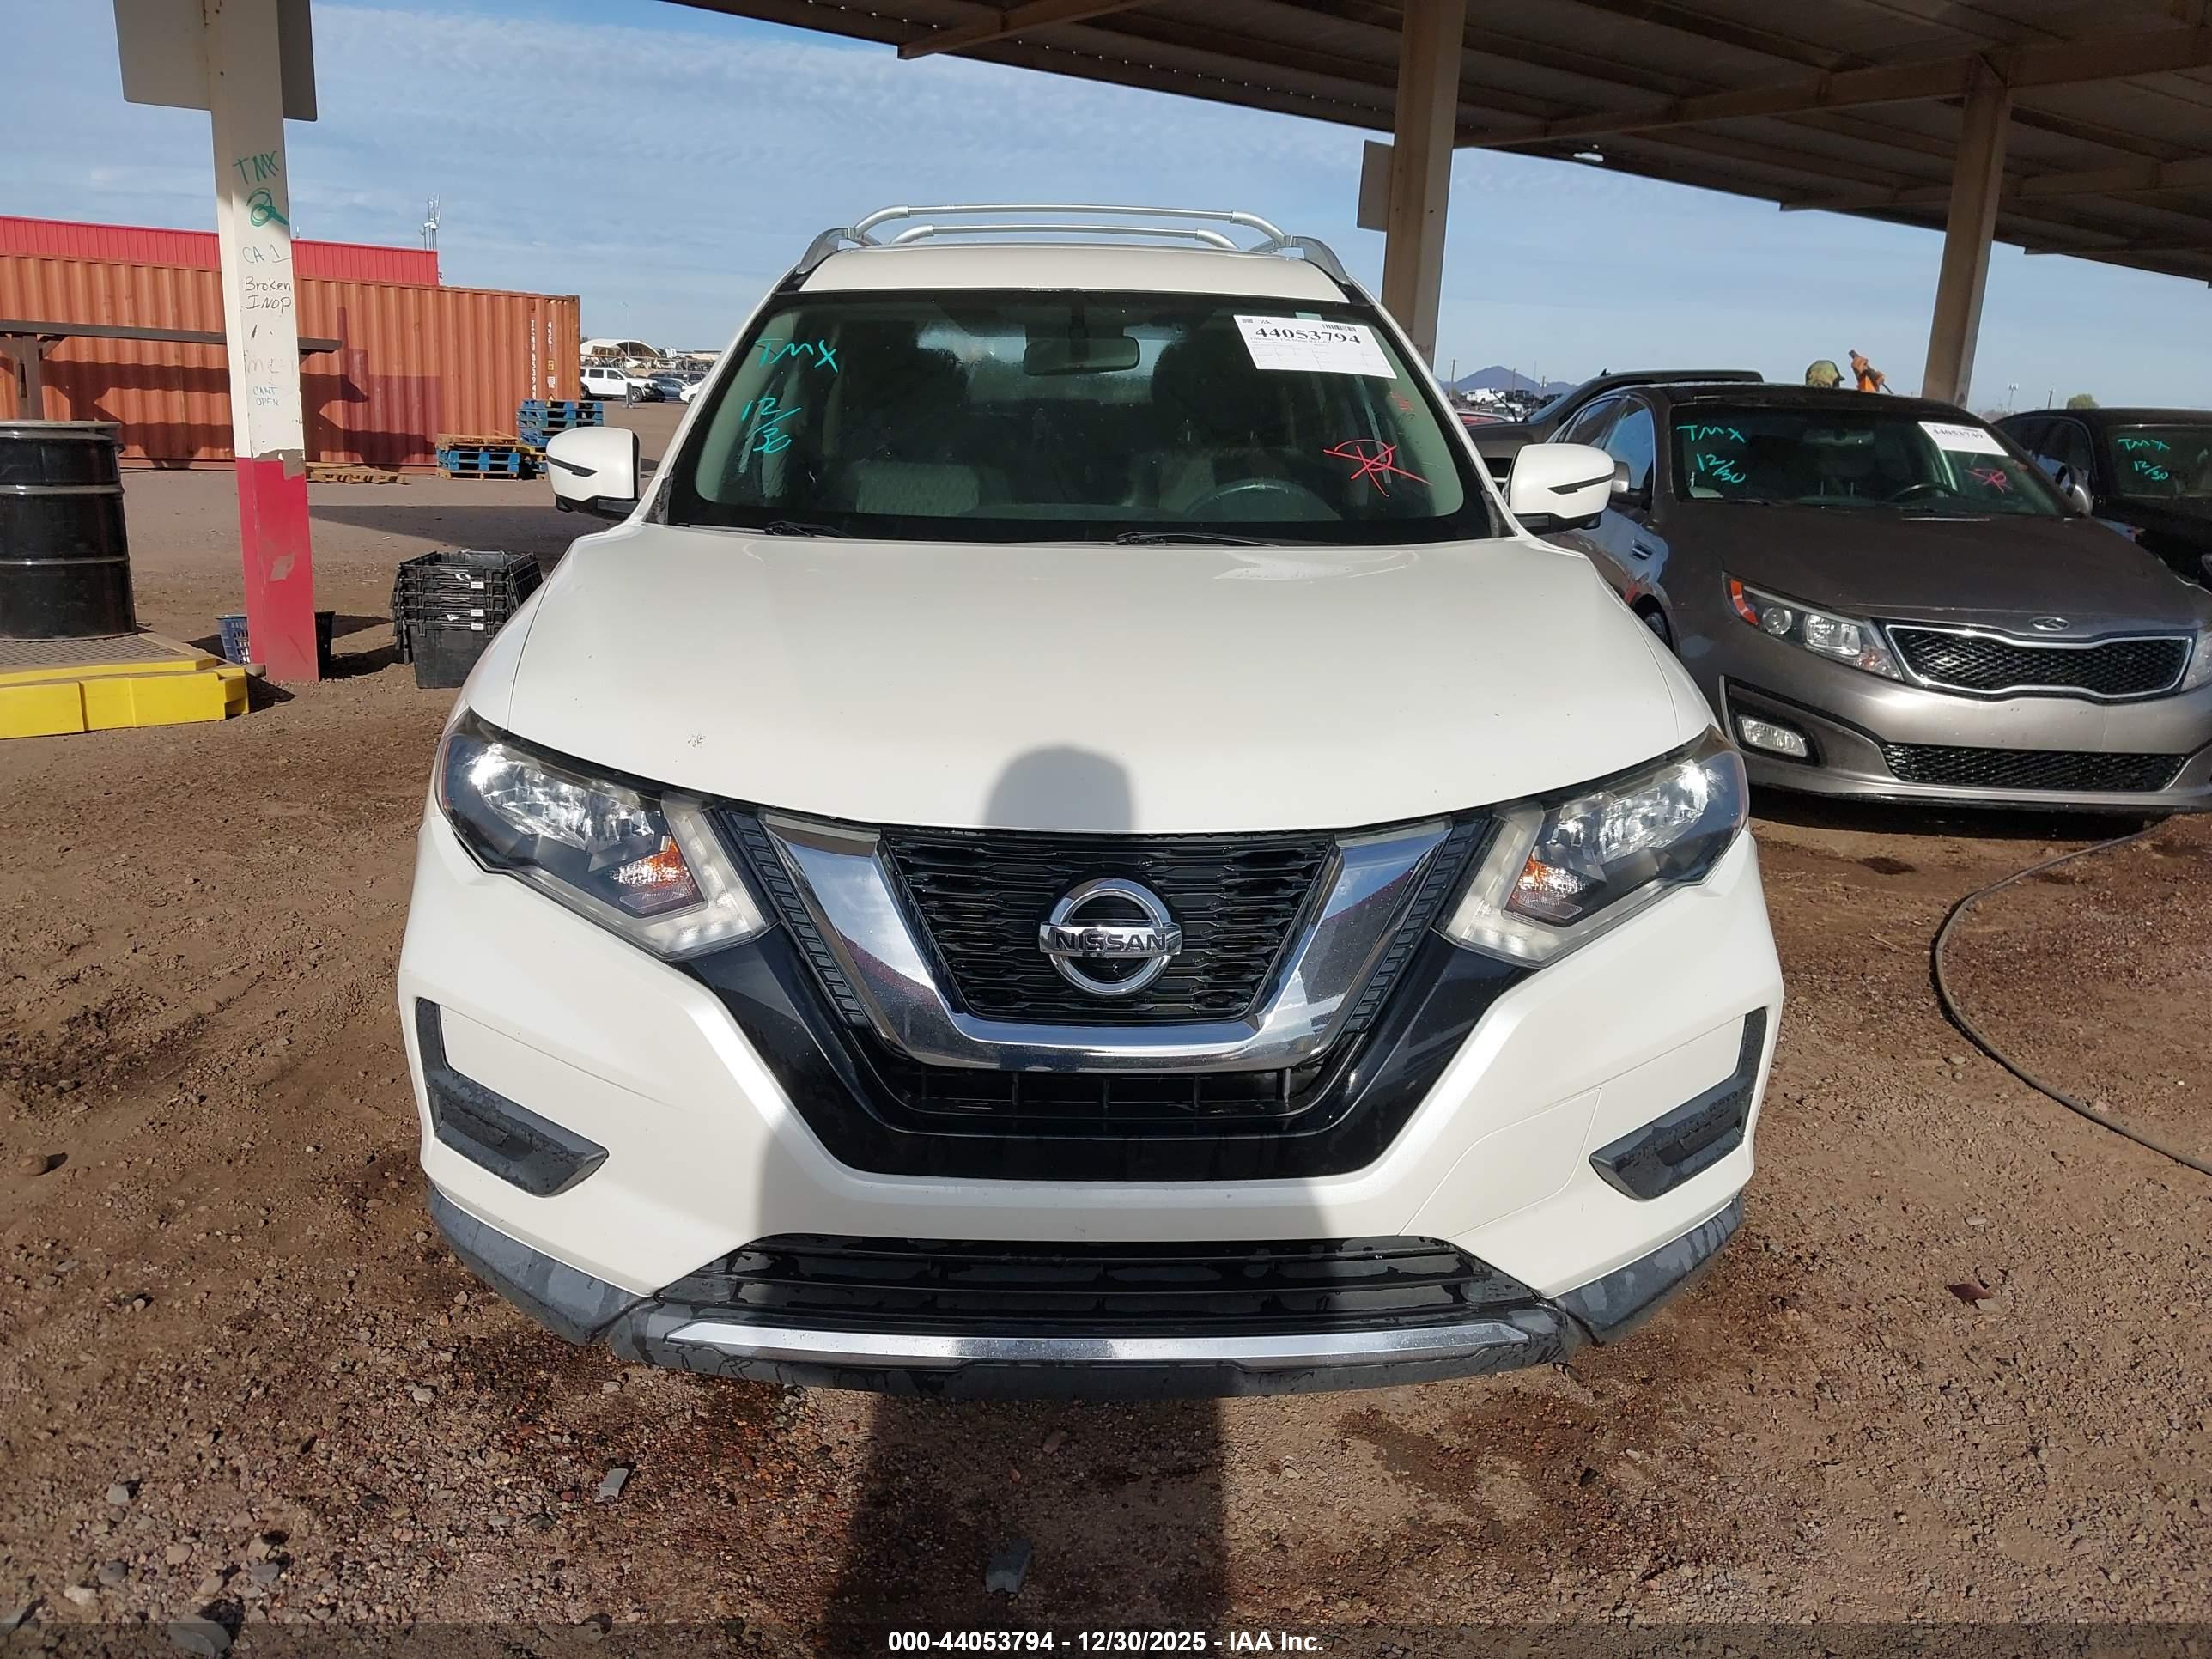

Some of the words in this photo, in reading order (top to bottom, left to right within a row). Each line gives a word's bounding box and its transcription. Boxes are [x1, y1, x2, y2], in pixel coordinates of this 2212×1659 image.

[245, 276, 291, 292] Broken
[246, 295, 292, 314] INOP
[1255, 327, 1361, 344] 44053794
[755, 338, 839, 373] TMX
[1676, 425, 1746, 443] TMX
[2118, 439, 2171, 451] TMX
[1055, 933, 1165, 951] NISSAN
